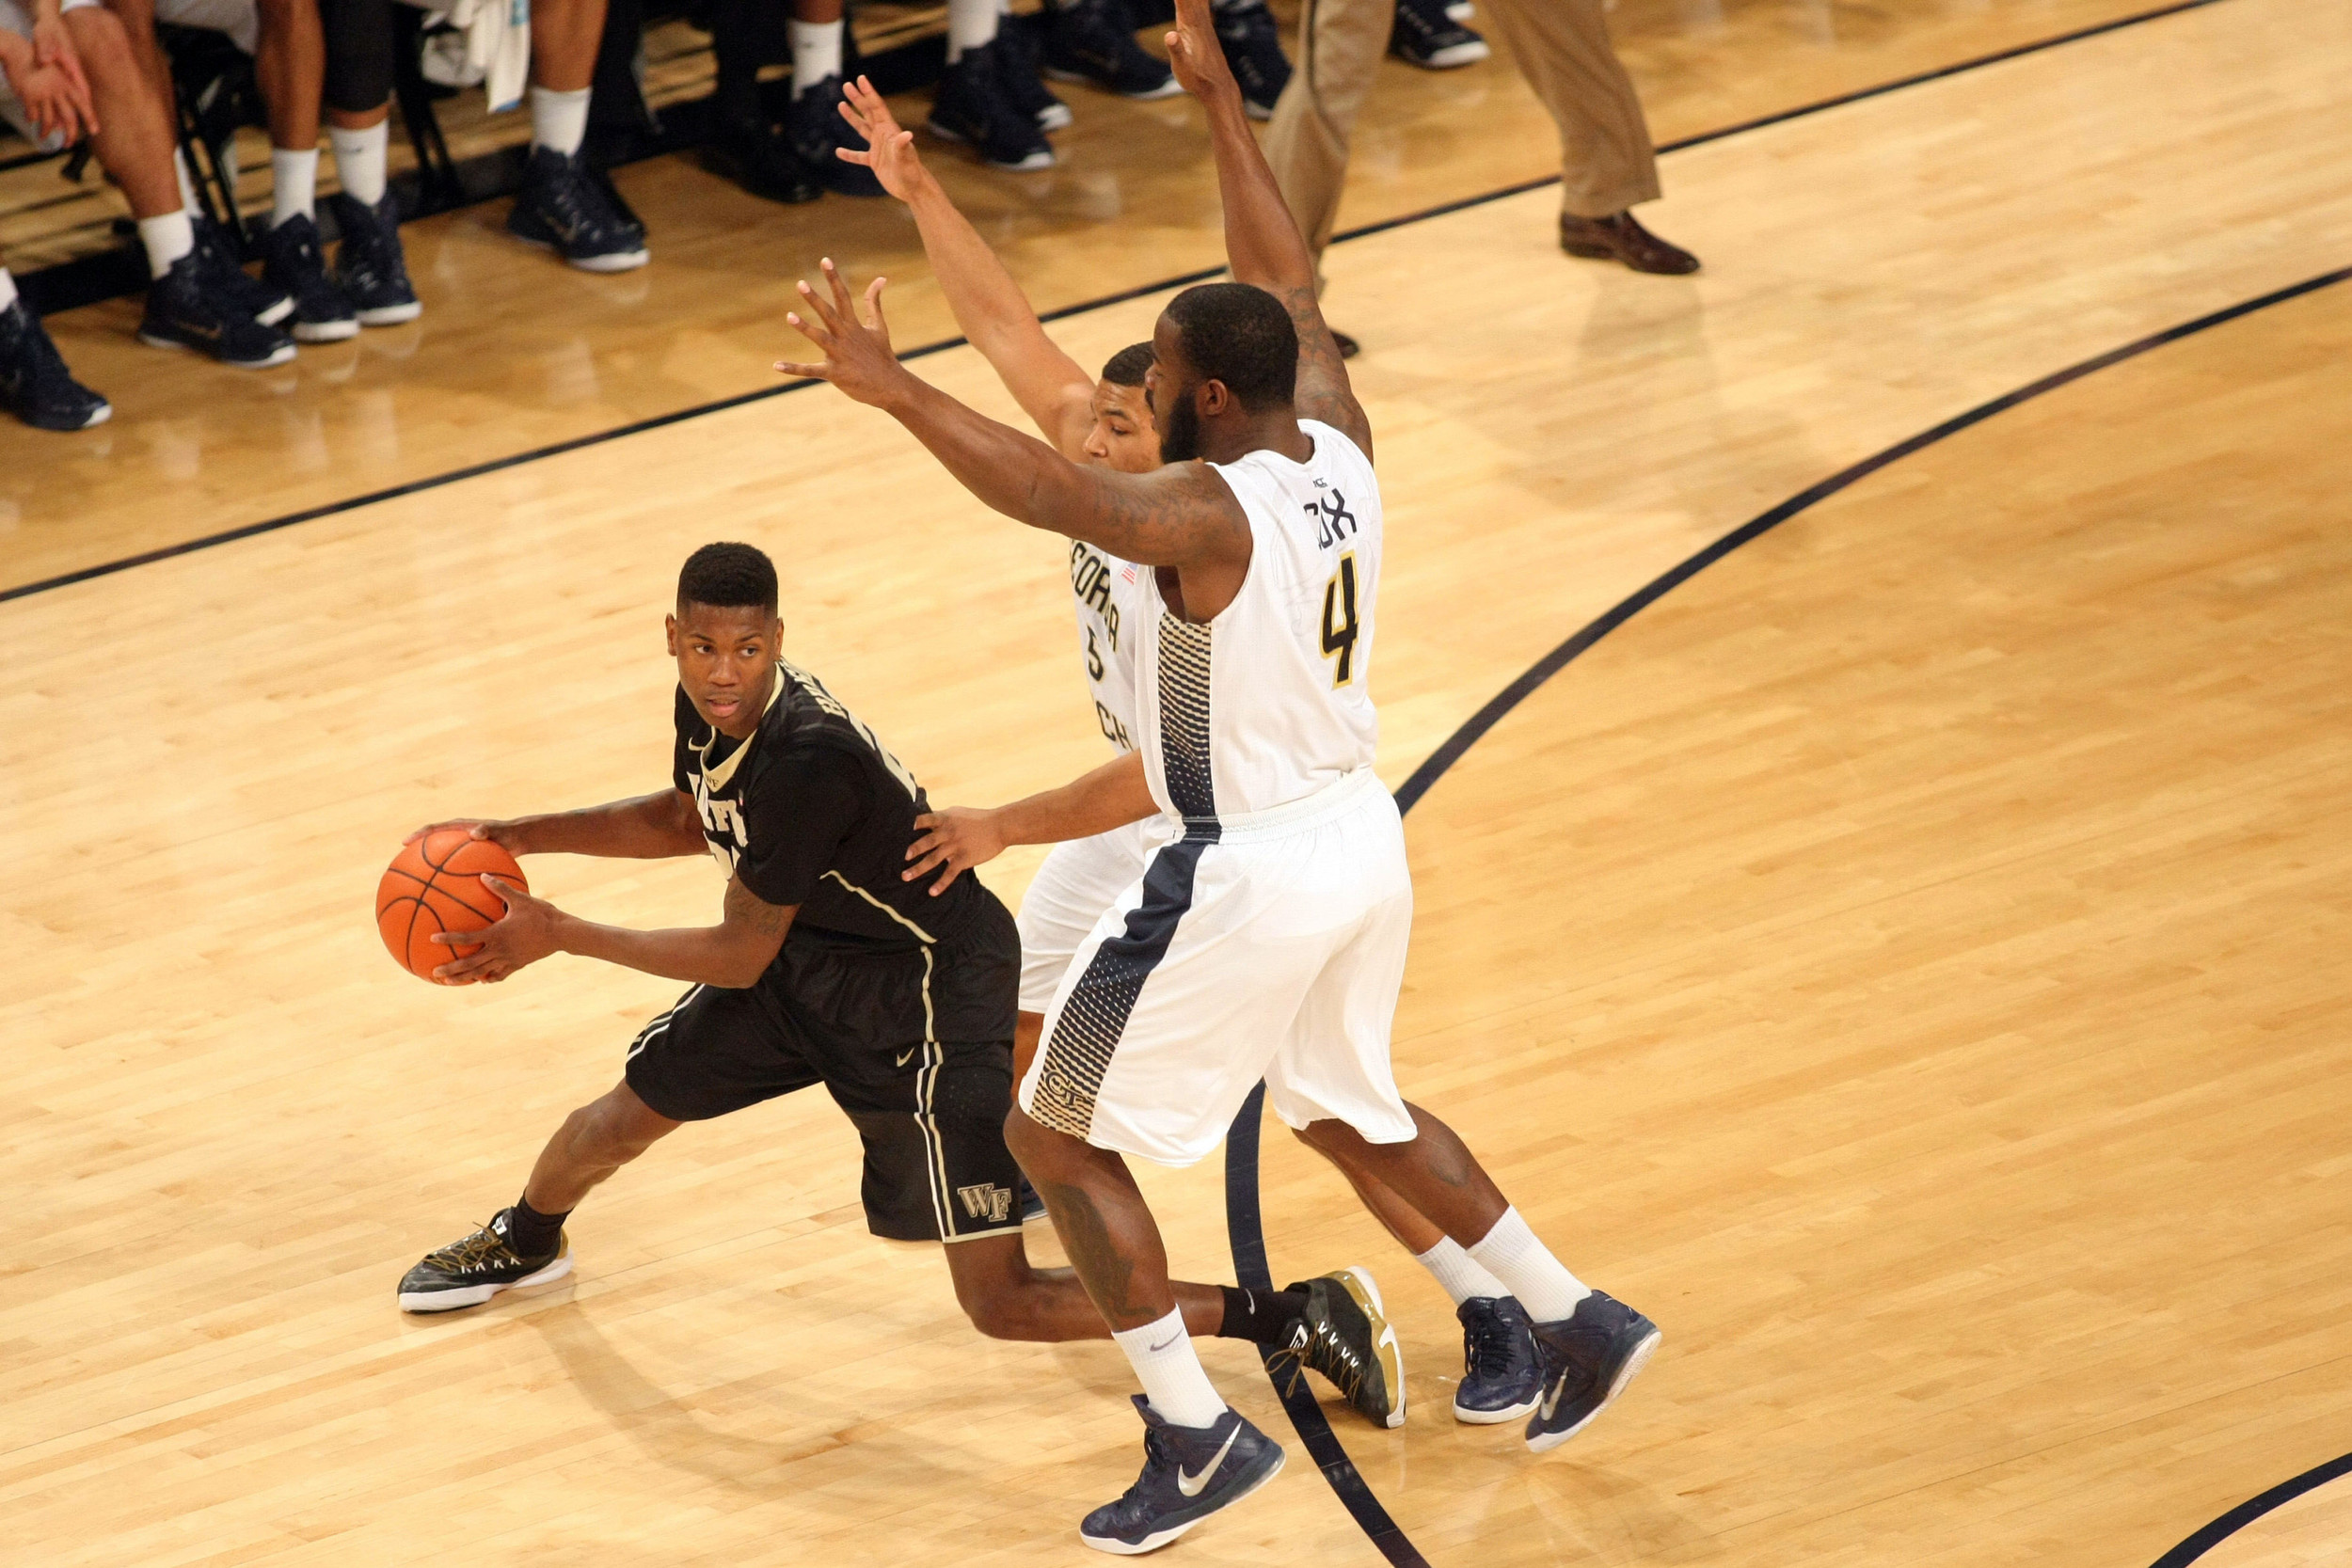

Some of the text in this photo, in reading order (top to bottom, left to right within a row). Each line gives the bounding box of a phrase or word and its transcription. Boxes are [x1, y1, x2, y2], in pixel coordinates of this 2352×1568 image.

[1319, 550, 1359, 689] 4
[1087, 625, 1104, 681] 5
[1096, 700, 1134, 752] CH
[957, 1182, 1011, 1222] WF
